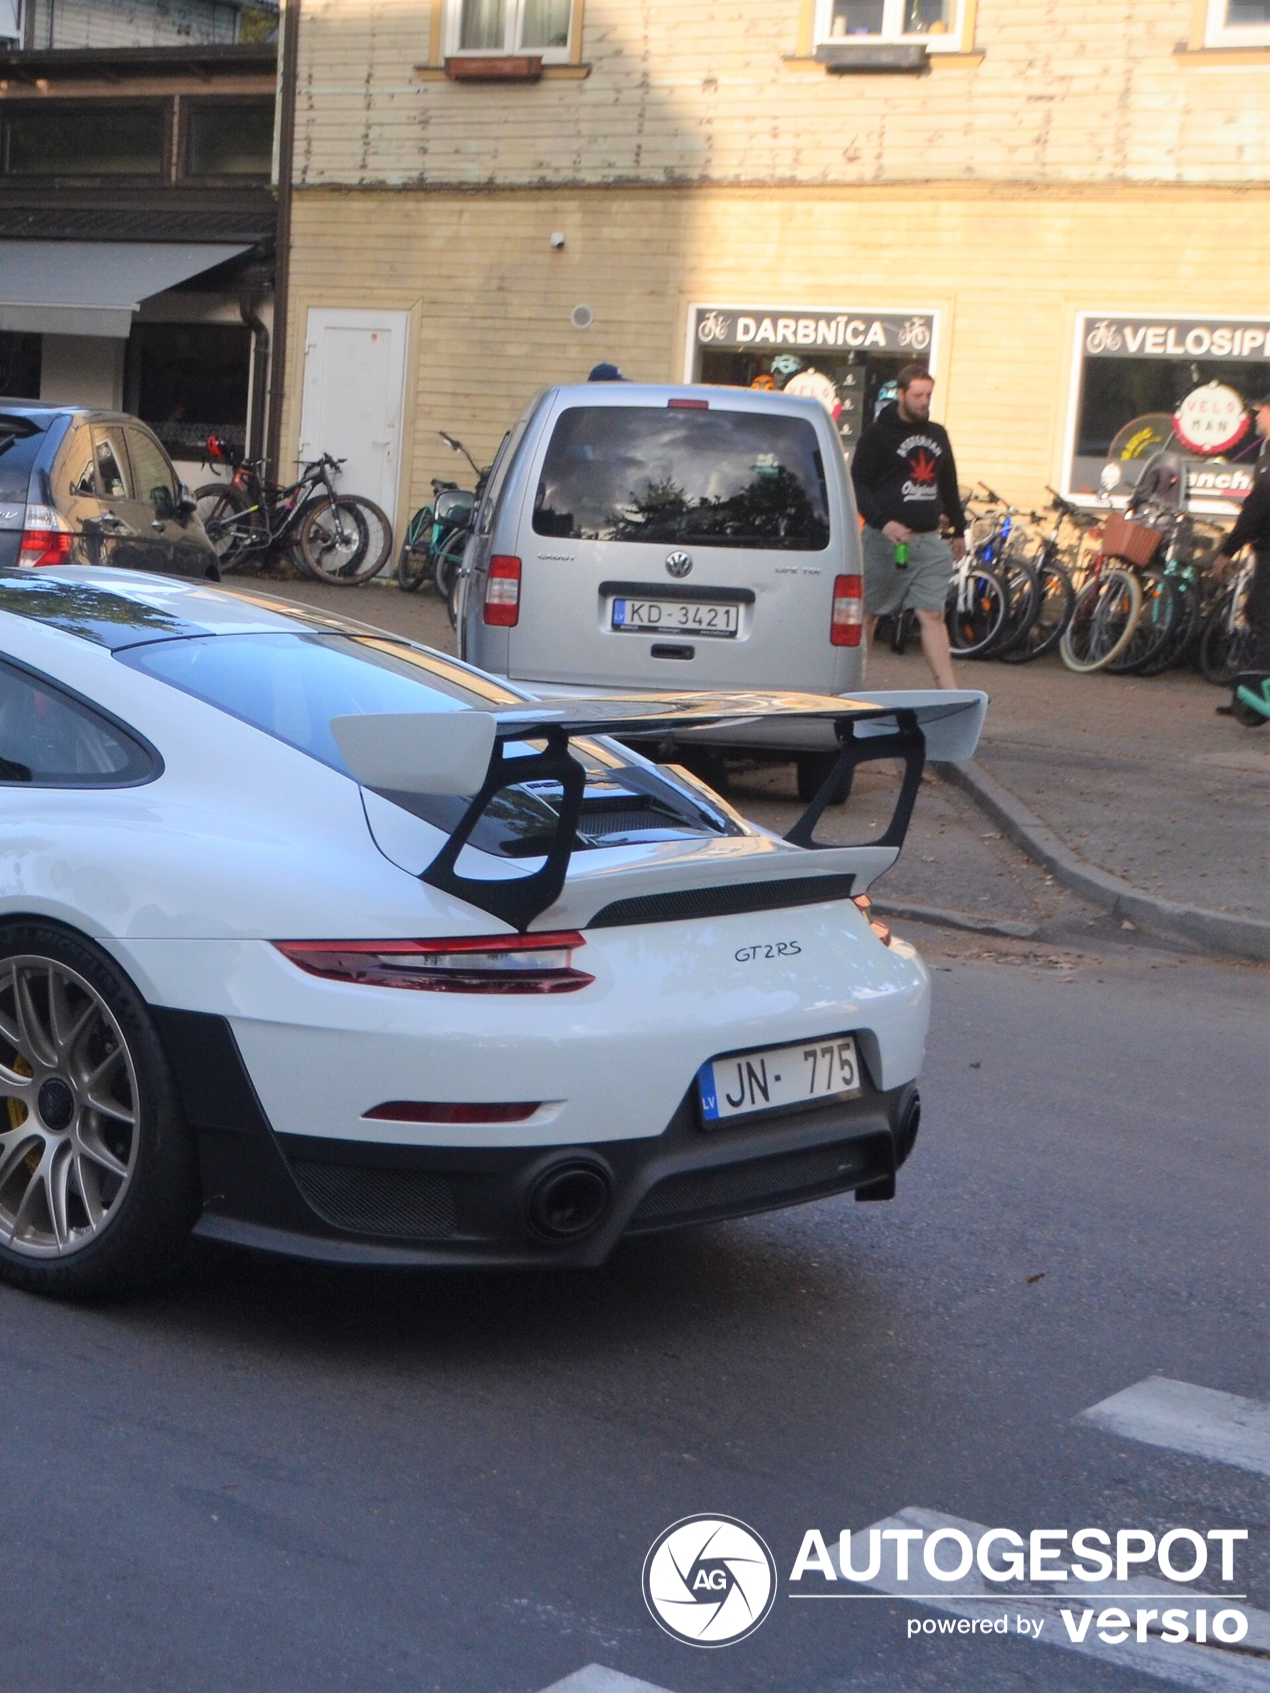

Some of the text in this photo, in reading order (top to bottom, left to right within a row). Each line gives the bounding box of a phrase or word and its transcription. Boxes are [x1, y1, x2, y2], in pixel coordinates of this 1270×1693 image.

[736, 315, 888, 347] DARBNĪCA
[1188, 401, 1236, 414] VELO
[1191, 420, 1229, 433] MAN
[1189, 470, 1253, 490] nch
[630, 603, 730, 628] KD-3421
[702, 1096, 716, 1110] LV
